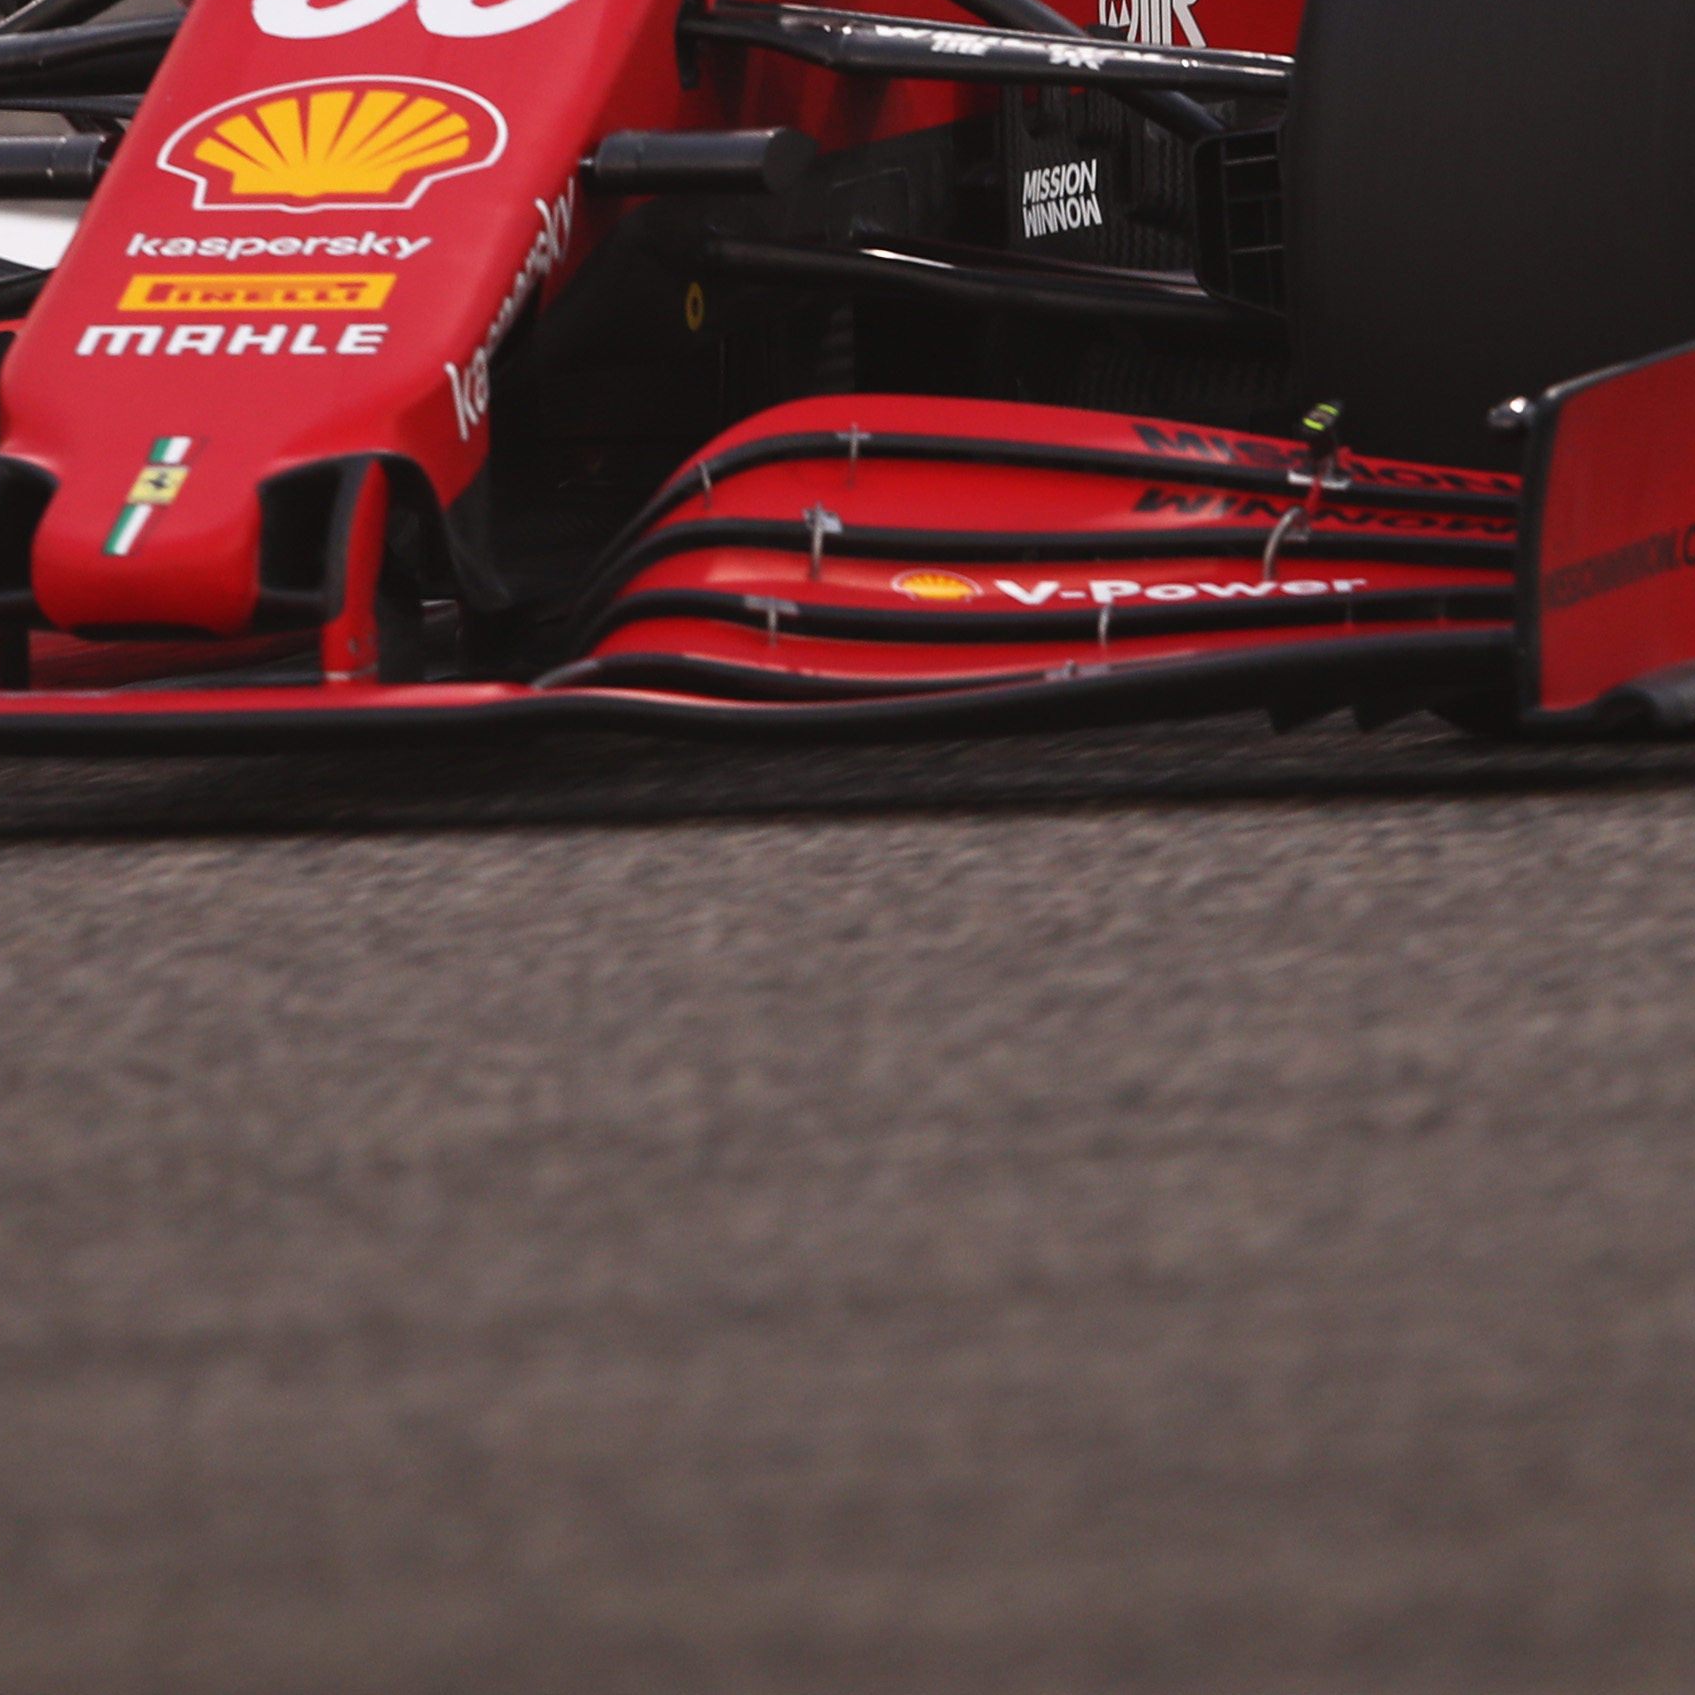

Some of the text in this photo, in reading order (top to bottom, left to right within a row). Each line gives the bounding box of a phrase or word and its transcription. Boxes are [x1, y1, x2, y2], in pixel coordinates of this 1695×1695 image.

[1022, 159, 1098, 205] MISSION
[1023, 193, 1102, 239] WINNOW
[126, 232, 433, 260] kaspersky
[995, 578, 1366, 606] V-Power
